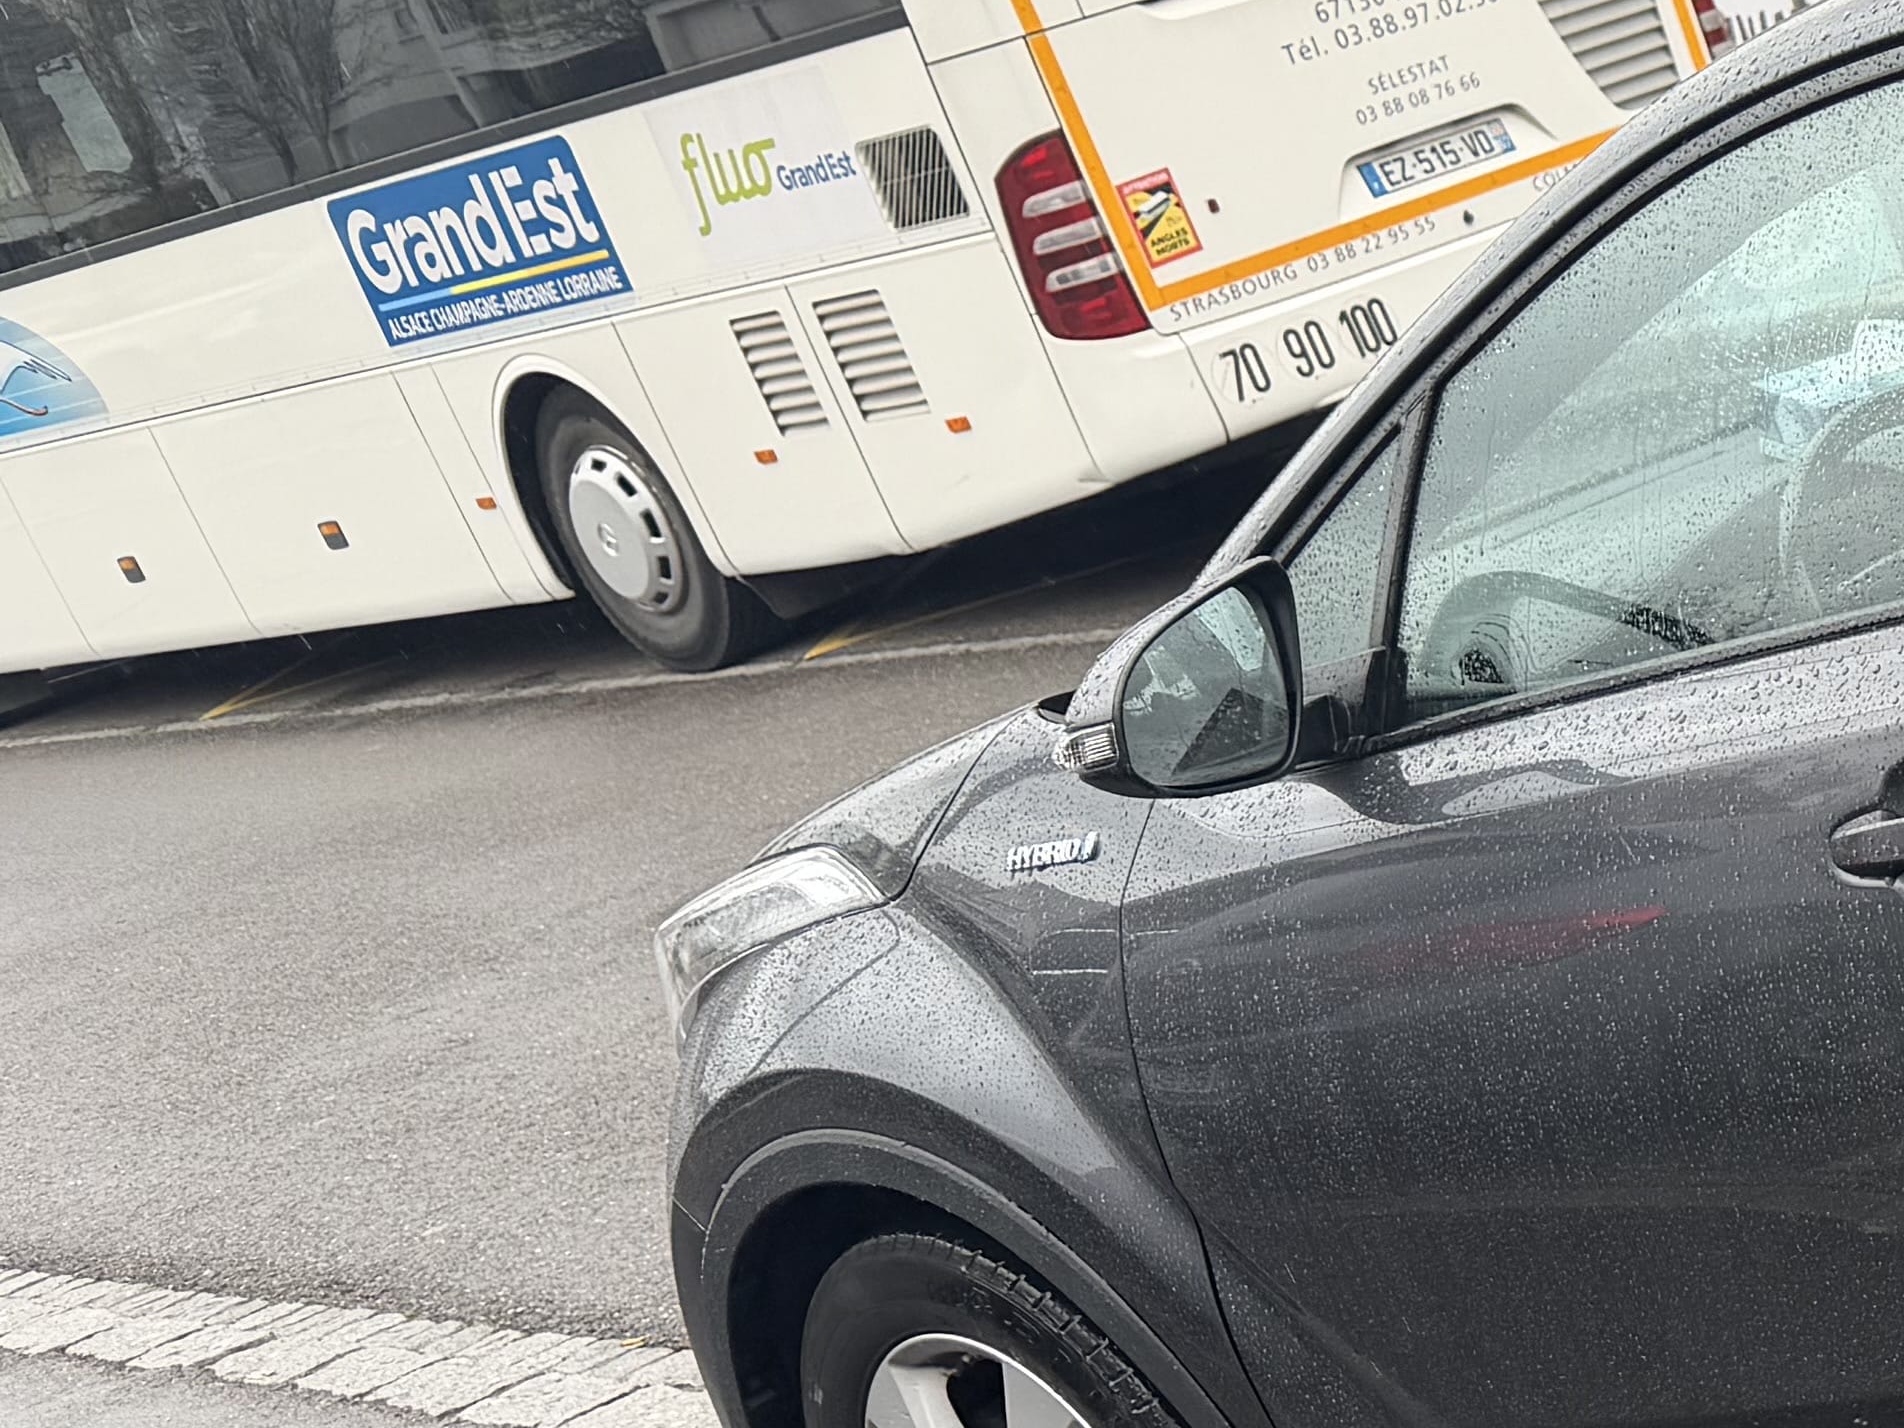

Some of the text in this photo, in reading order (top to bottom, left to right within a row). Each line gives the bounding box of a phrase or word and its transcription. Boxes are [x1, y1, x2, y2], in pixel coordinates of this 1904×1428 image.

[1281, 36, 1329, 65] Tél.
[1368, 55, 1450, 95] SÉLESTAT
[1355, 71, 1481, 126] 03 88 08 76 66
[680, 132, 776, 237] fluo
[1378, 129, 1496, 188] EZ-515-VD
[1150, 227, 1188, 248] ANGLES
[1169, 216, 1436, 322] STRASBOURG 03 88 22 95 55
[387, 313, 430, 341] ALSACE
[560, 266, 623, 302] LORRAINE
[1218, 297, 1399, 402] 70 90 100
[1006, 837, 1081, 872] HYBRID
